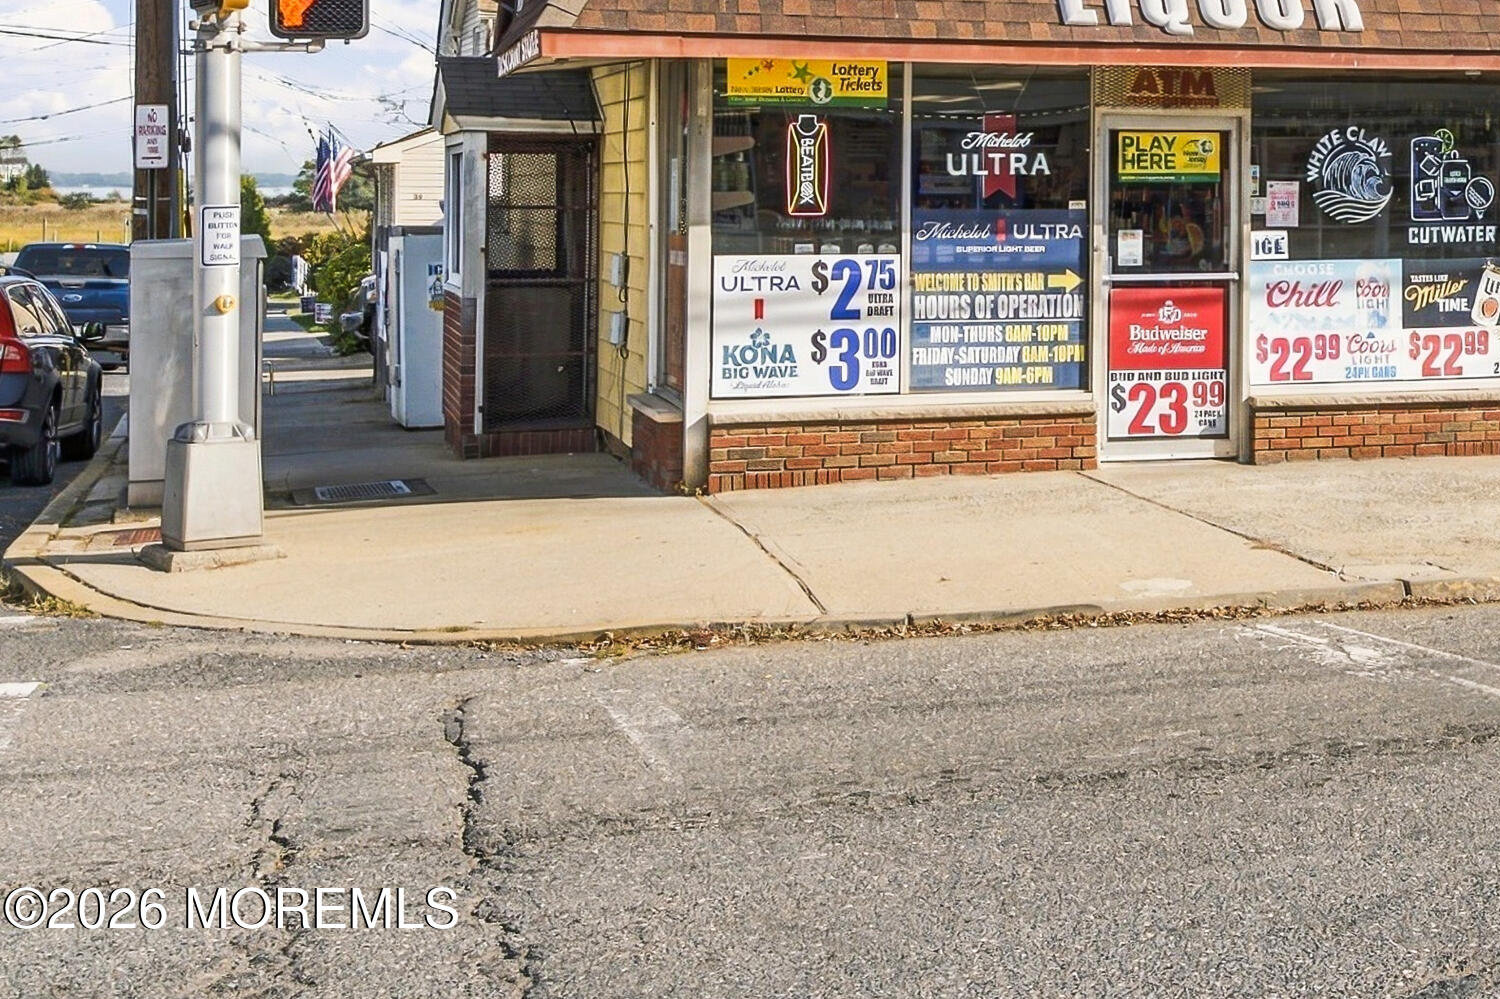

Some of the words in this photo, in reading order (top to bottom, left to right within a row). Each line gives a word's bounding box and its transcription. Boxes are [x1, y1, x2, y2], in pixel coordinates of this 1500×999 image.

[832, 63, 879, 79] Lottery
[775, 86, 805, 96] Lottery
[839, 77, 883, 92] Tickets
[1129, 70, 1217, 98] ATM
[147, 112, 157, 122] NO
[138, 125, 167, 136] PARKING
[961, 132, 1035, 149] Michelob
[1121, 135, 1177, 152] PLAY
[1121, 153, 1177, 170] HERE
[1306, 129, 1344, 183] WHITE
[1346, 126, 1393, 158] CLAW
[799, 138, 815, 205] BEATBOX
[946, 153, 1051, 176] ULTRA
[208, 222, 238, 230] BUTTON
[916, 221, 991, 241] Michelob
[1013, 223, 1083, 240] ULTRA
[1408, 225, 1497, 244] CUTWATER
[1024, 245, 1046, 253] BEER
[1255, 236, 1285, 256] ICE
[1273, 263, 1336, 276] CHOOSE
[721, 275, 801, 292] ULTRA
[914, 272, 964, 292] WELCOME
[966, 273, 979, 292] TO
[1024, 272, 1045, 292] BAR
[1265, 280, 1344, 308] Chill
[1404, 279, 1469, 312] Miller
[867, 305, 894, 317] DRAFT
[914, 295, 971, 320] HOURS
[975, 295, 995, 320] OF
[997, 294, 1084, 319] OPERATION
[1437, 298, 1471, 313] TIME
[930, 325, 1003, 344] MON-THURS
[1129, 324, 1208, 341] Budweiser
[1127, 341, 1157, 354] Made
[1346, 334, 1397, 354] Coors
[722, 343, 797, 368] KONA
[912, 345, 1021, 366] FRIDAY-SATURDAY
[1352, 355, 1390, 366] LIGHT
[722, 366, 749, 380] BIG
[757, 365, 799, 379] WAVE
[945, 367, 994, 386] SUNDAY
[995, 366, 1054, 384] 9AM-6PM
[1111, 372, 1135, 382] BUD
[1137, 371, 1162, 381] AND
[1164, 371, 1189, 381] BUD
[1192, 371, 1225, 381] LIGHT
